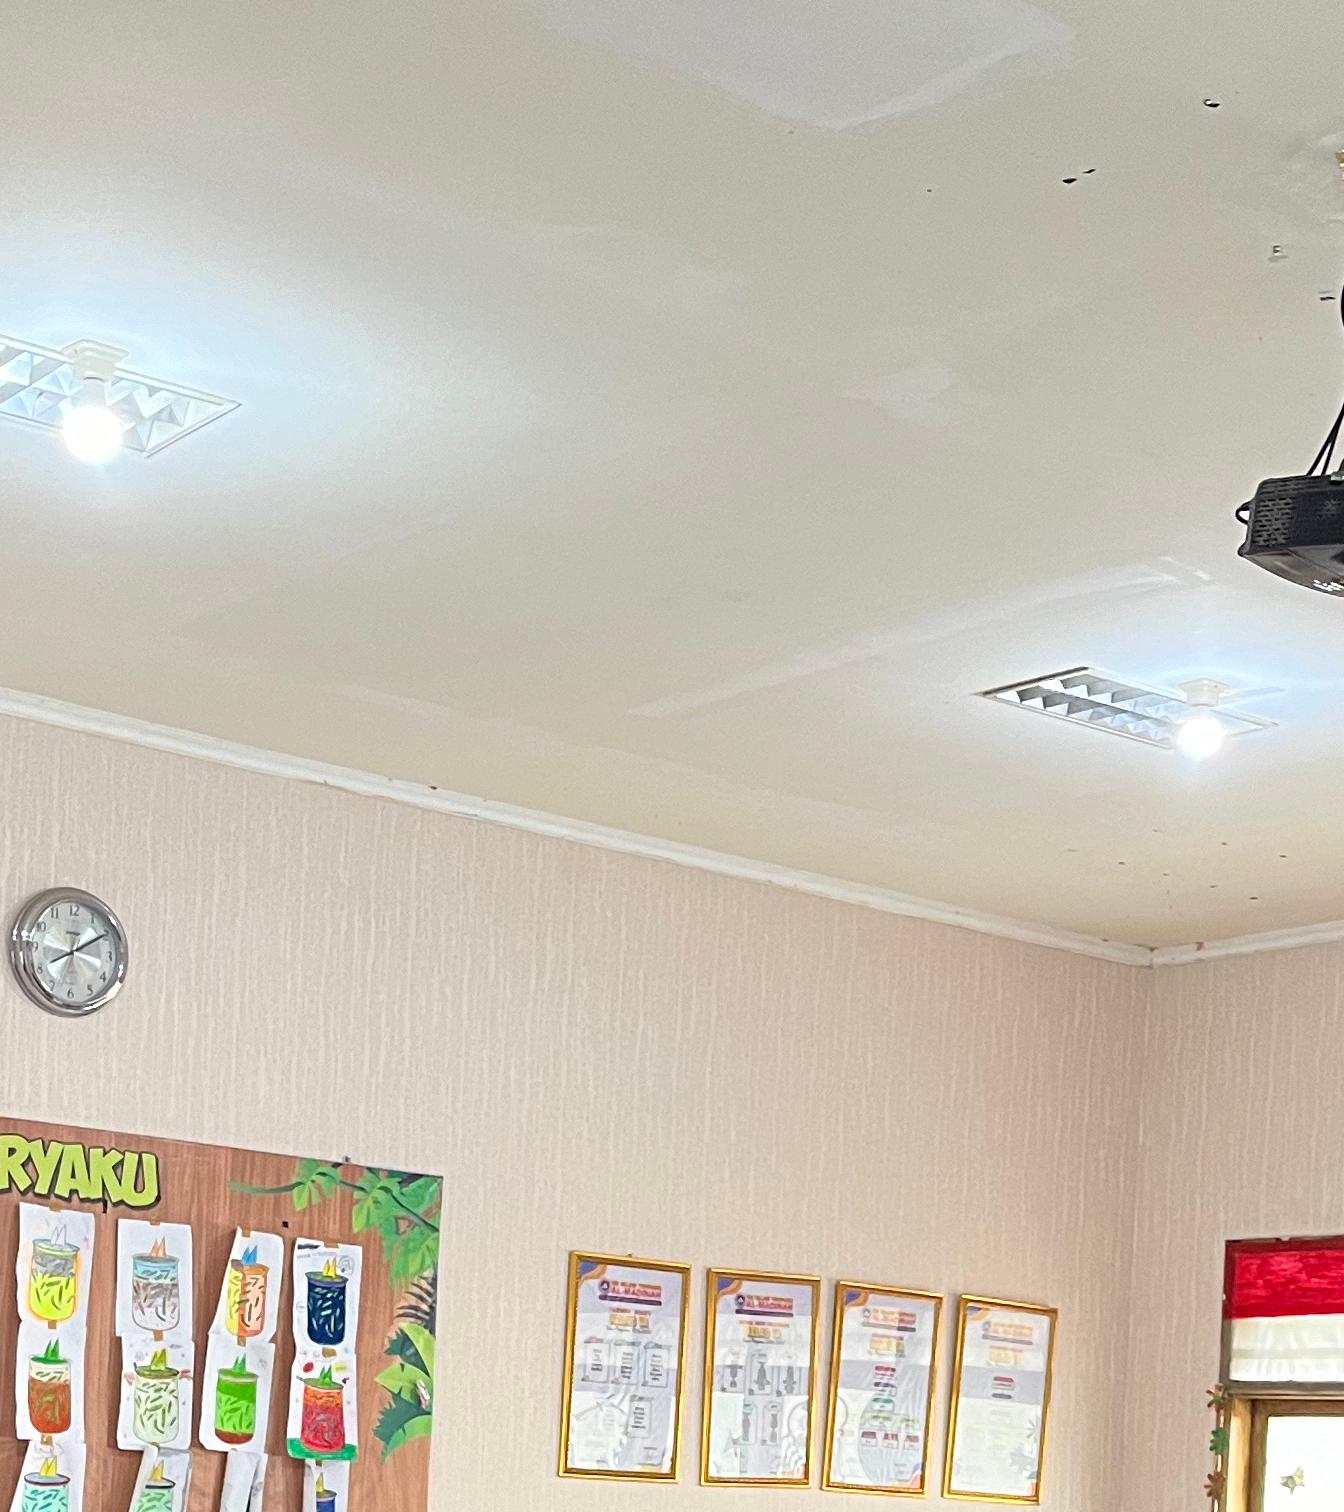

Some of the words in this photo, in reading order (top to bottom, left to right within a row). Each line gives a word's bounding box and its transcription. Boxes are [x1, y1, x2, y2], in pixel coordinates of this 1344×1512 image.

[50, 907, 59, 919] 11
[69, 904, 80, 917] 12
[36, 921, 47, 932] 10
[99, 971, 107, 983] 4
[49, 980, 56, 992] 7
[86, 984, 94, 996] 5
[67, 987, 75, 999] 6
